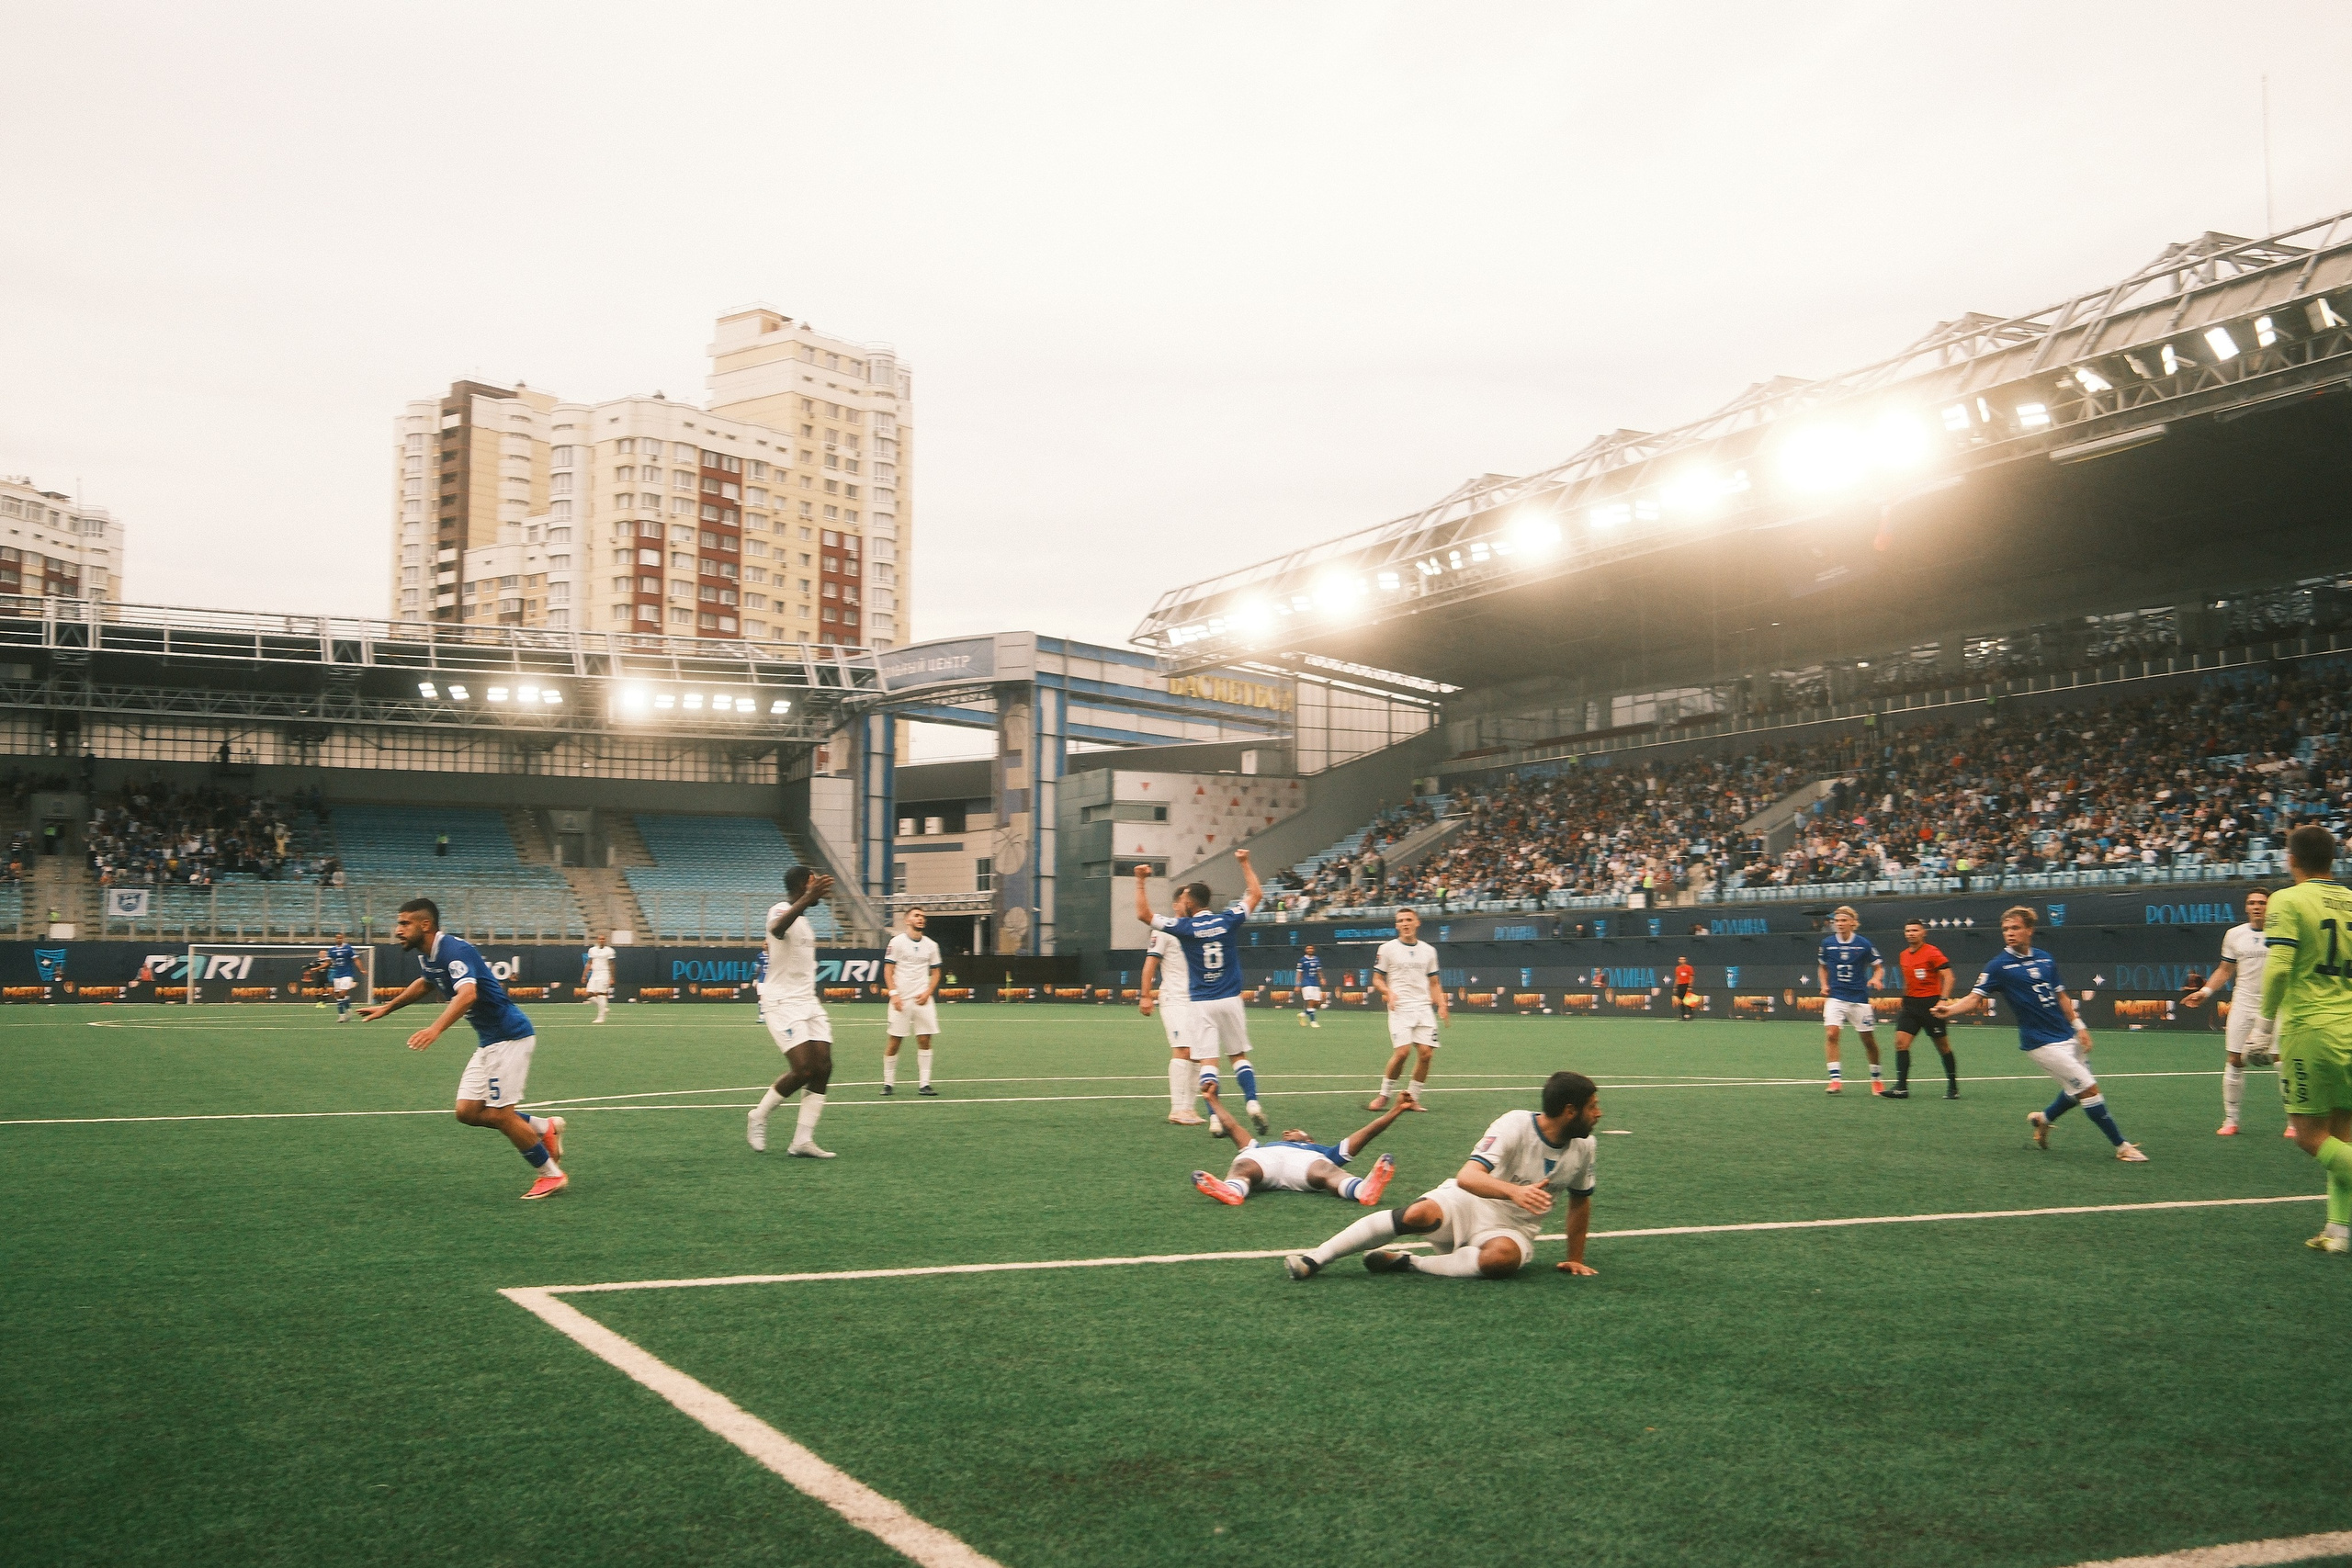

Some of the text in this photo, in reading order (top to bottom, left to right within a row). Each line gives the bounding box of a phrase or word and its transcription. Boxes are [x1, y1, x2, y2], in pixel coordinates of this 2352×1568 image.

[144, 954, 253, 980] PARI
[1202, 942, 1224, 969] 8
[488, 1078, 501, 1100] 5
